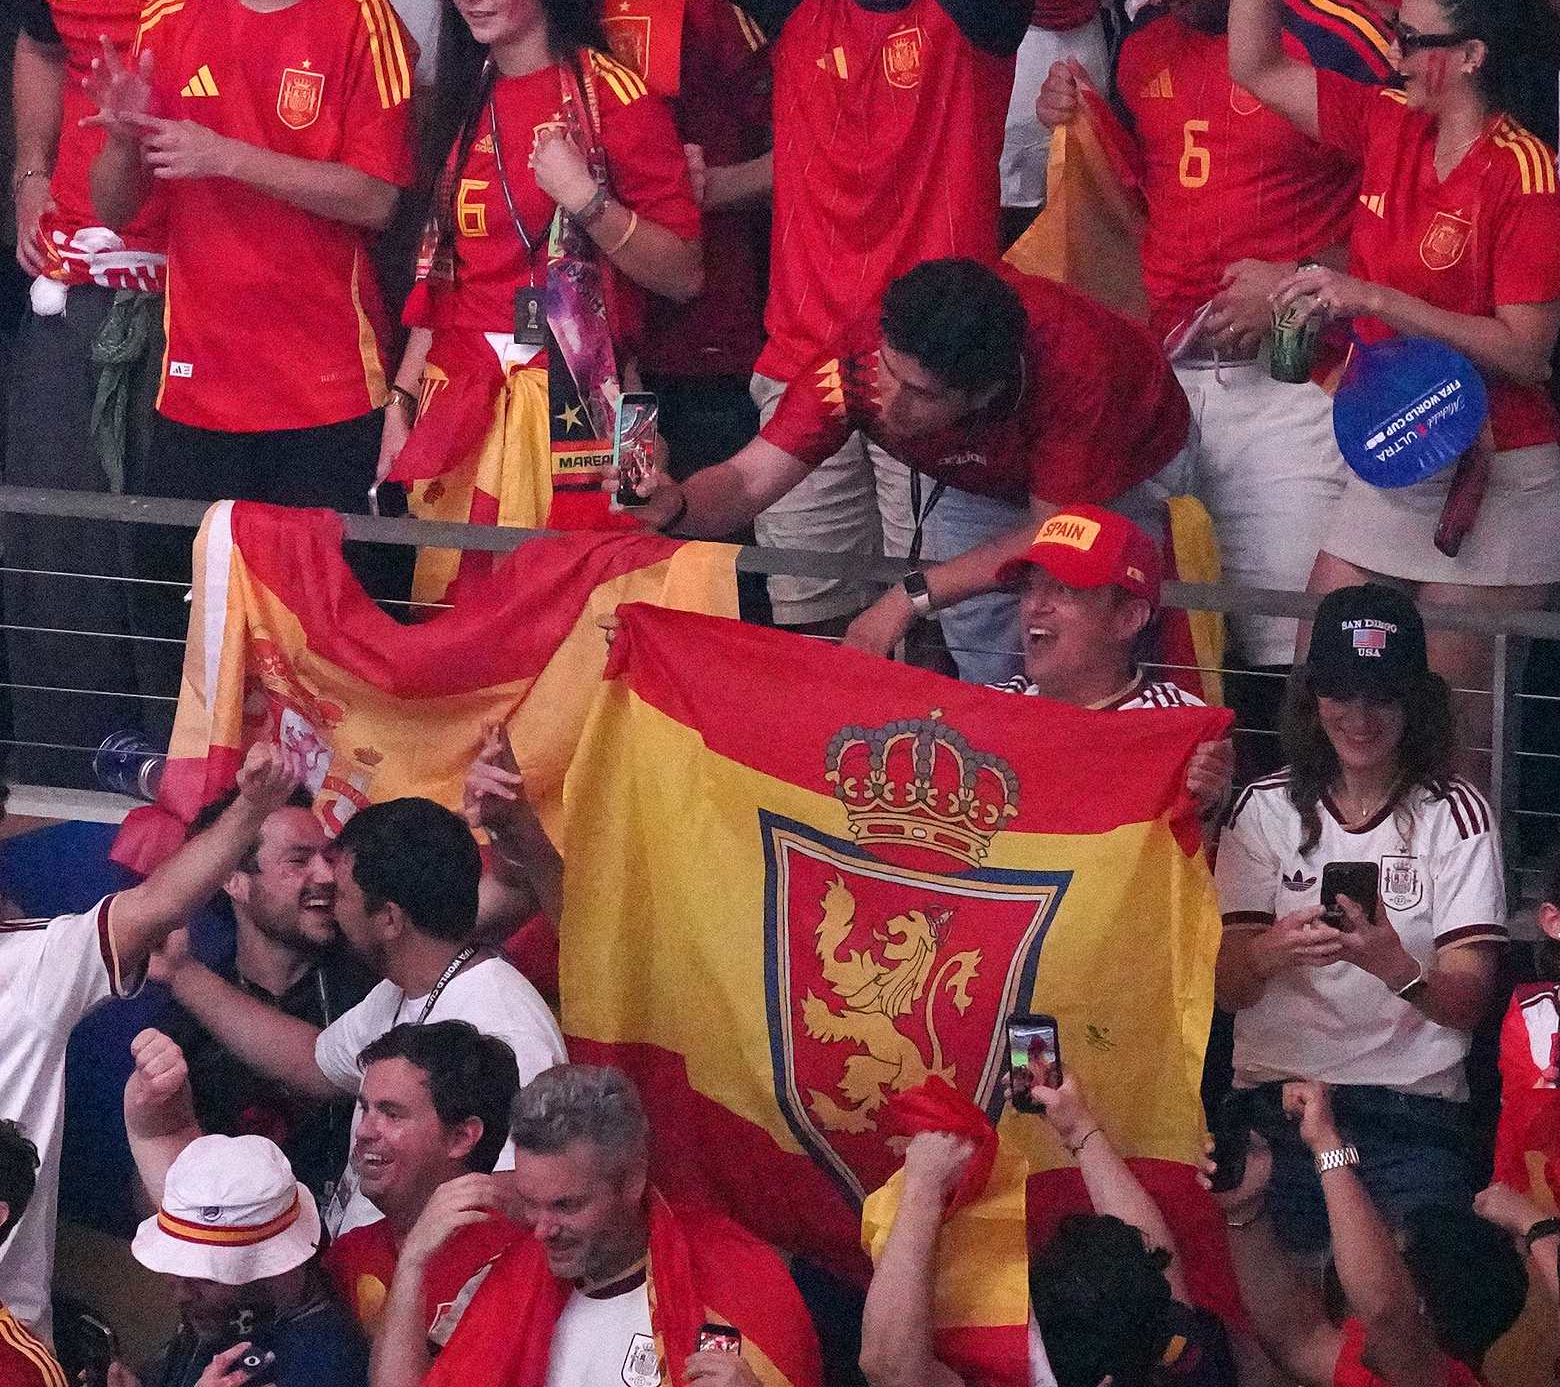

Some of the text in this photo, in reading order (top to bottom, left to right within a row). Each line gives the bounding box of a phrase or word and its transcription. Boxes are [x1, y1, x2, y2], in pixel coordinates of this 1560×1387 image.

[1179, 119, 1211, 189] 6
[457, 178, 490, 238] 6
[1408, 391, 1445, 419] WORLD
[1376, 429, 1420, 462] ULTRA
[1043, 520, 1086, 542] SPAIN
[1341, 618, 1398, 634] SAN DIEGO
[1357, 648, 1382, 658] USA
